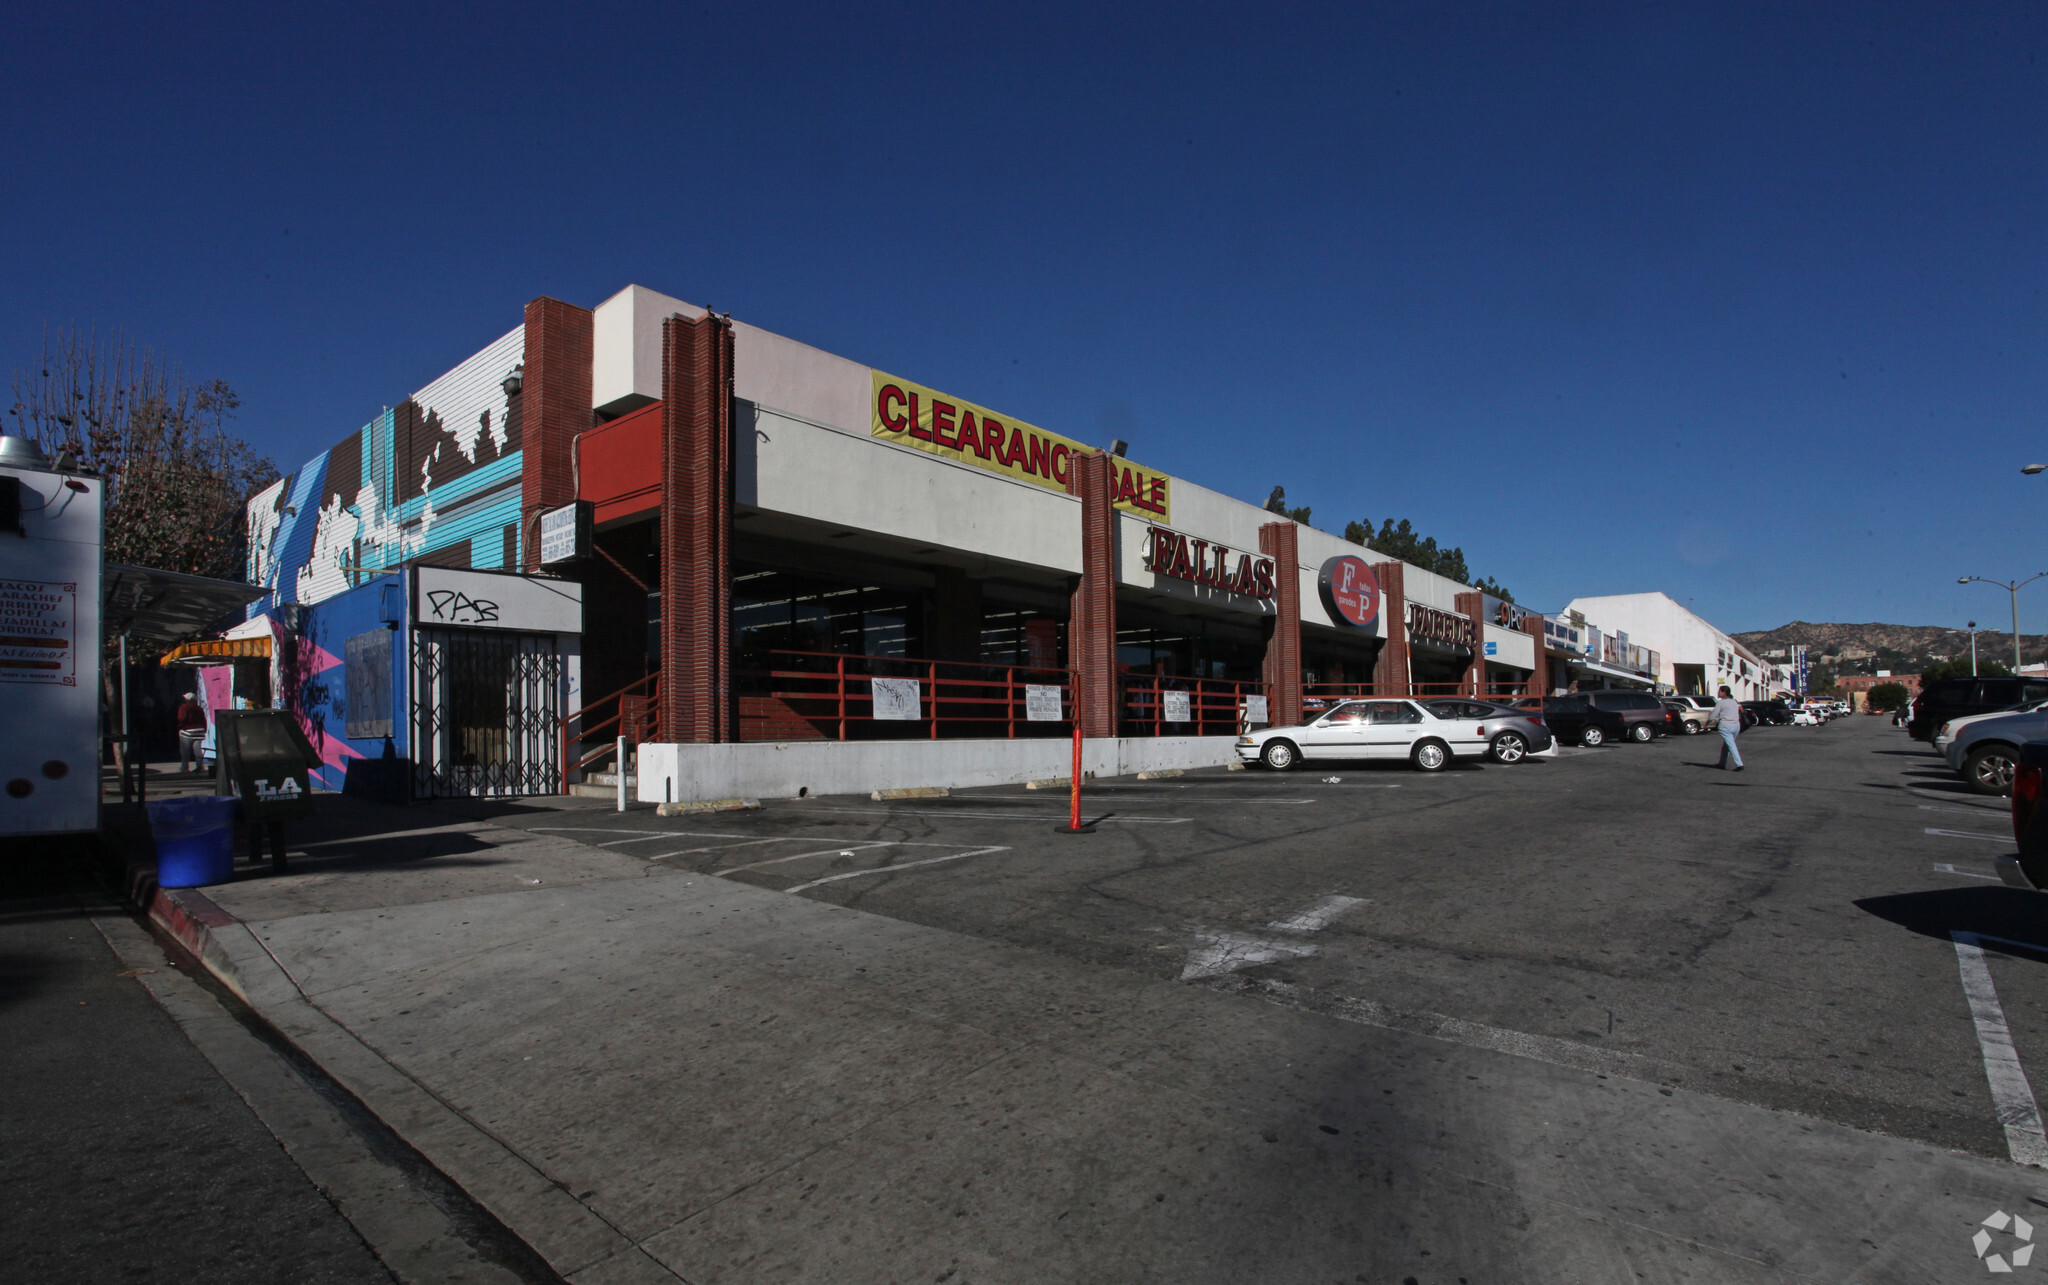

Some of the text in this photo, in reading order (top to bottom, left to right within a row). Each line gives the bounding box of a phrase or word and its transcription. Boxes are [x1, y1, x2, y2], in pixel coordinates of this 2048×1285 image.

[878, 384, 1080, 485] CLEARANC
[1148, 526, 1275, 600] FALLAS
[1341, 562, 1355, 594] F
[1358, 594, 1370, 620] P
[1410, 603, 1478, 648] PAREDES
[254, 777, 303, 796] LA
